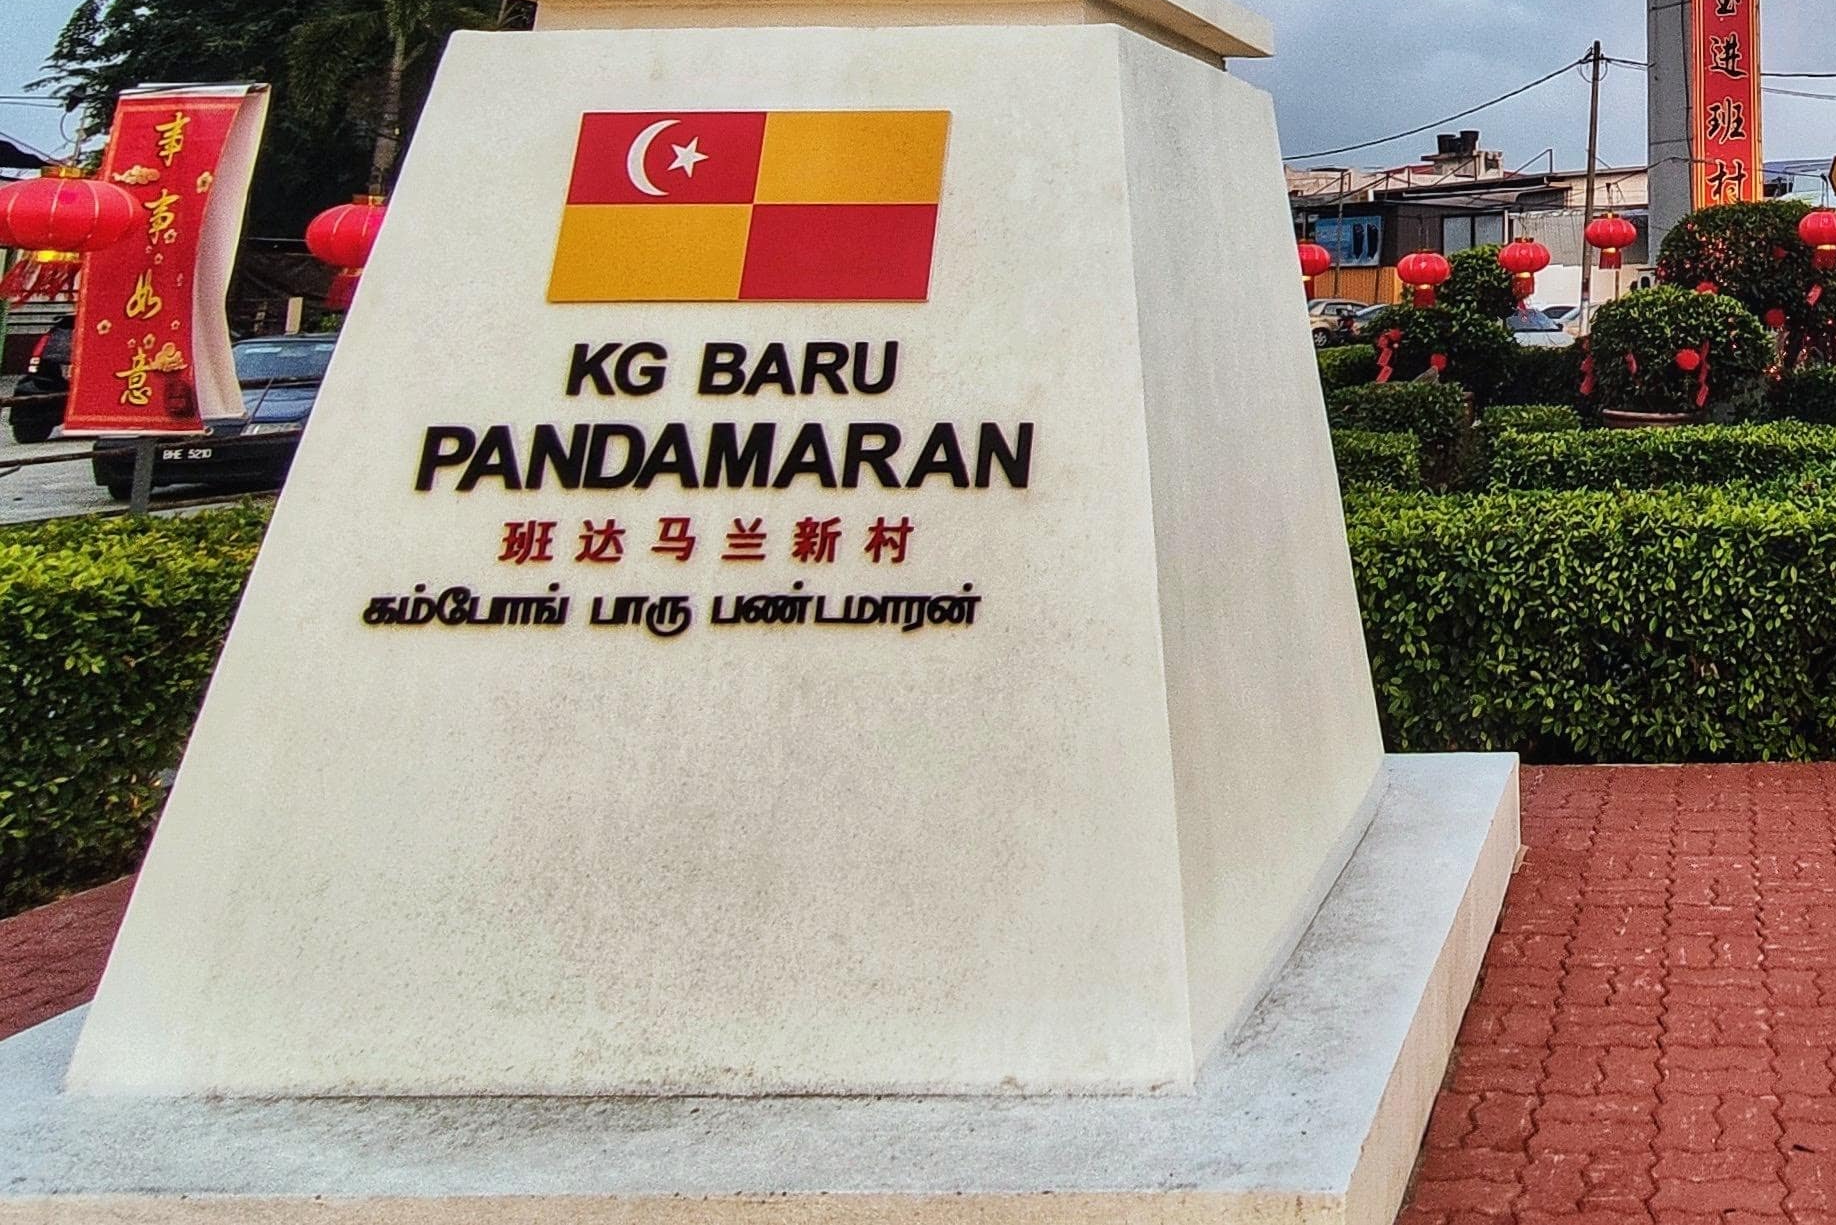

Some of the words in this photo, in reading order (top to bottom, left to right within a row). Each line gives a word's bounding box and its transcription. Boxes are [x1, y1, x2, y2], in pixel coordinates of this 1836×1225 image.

[115, 111, 193, 406] 事事如意
[566, 341, 667, 396] KG
[699, 340, 899, 396] BARU
[414, 422, 1034, 493] PANDAMARAN
[497, 516, 915, 565] 班达马兰新村
[589, 590, 690, 637] பாரு
